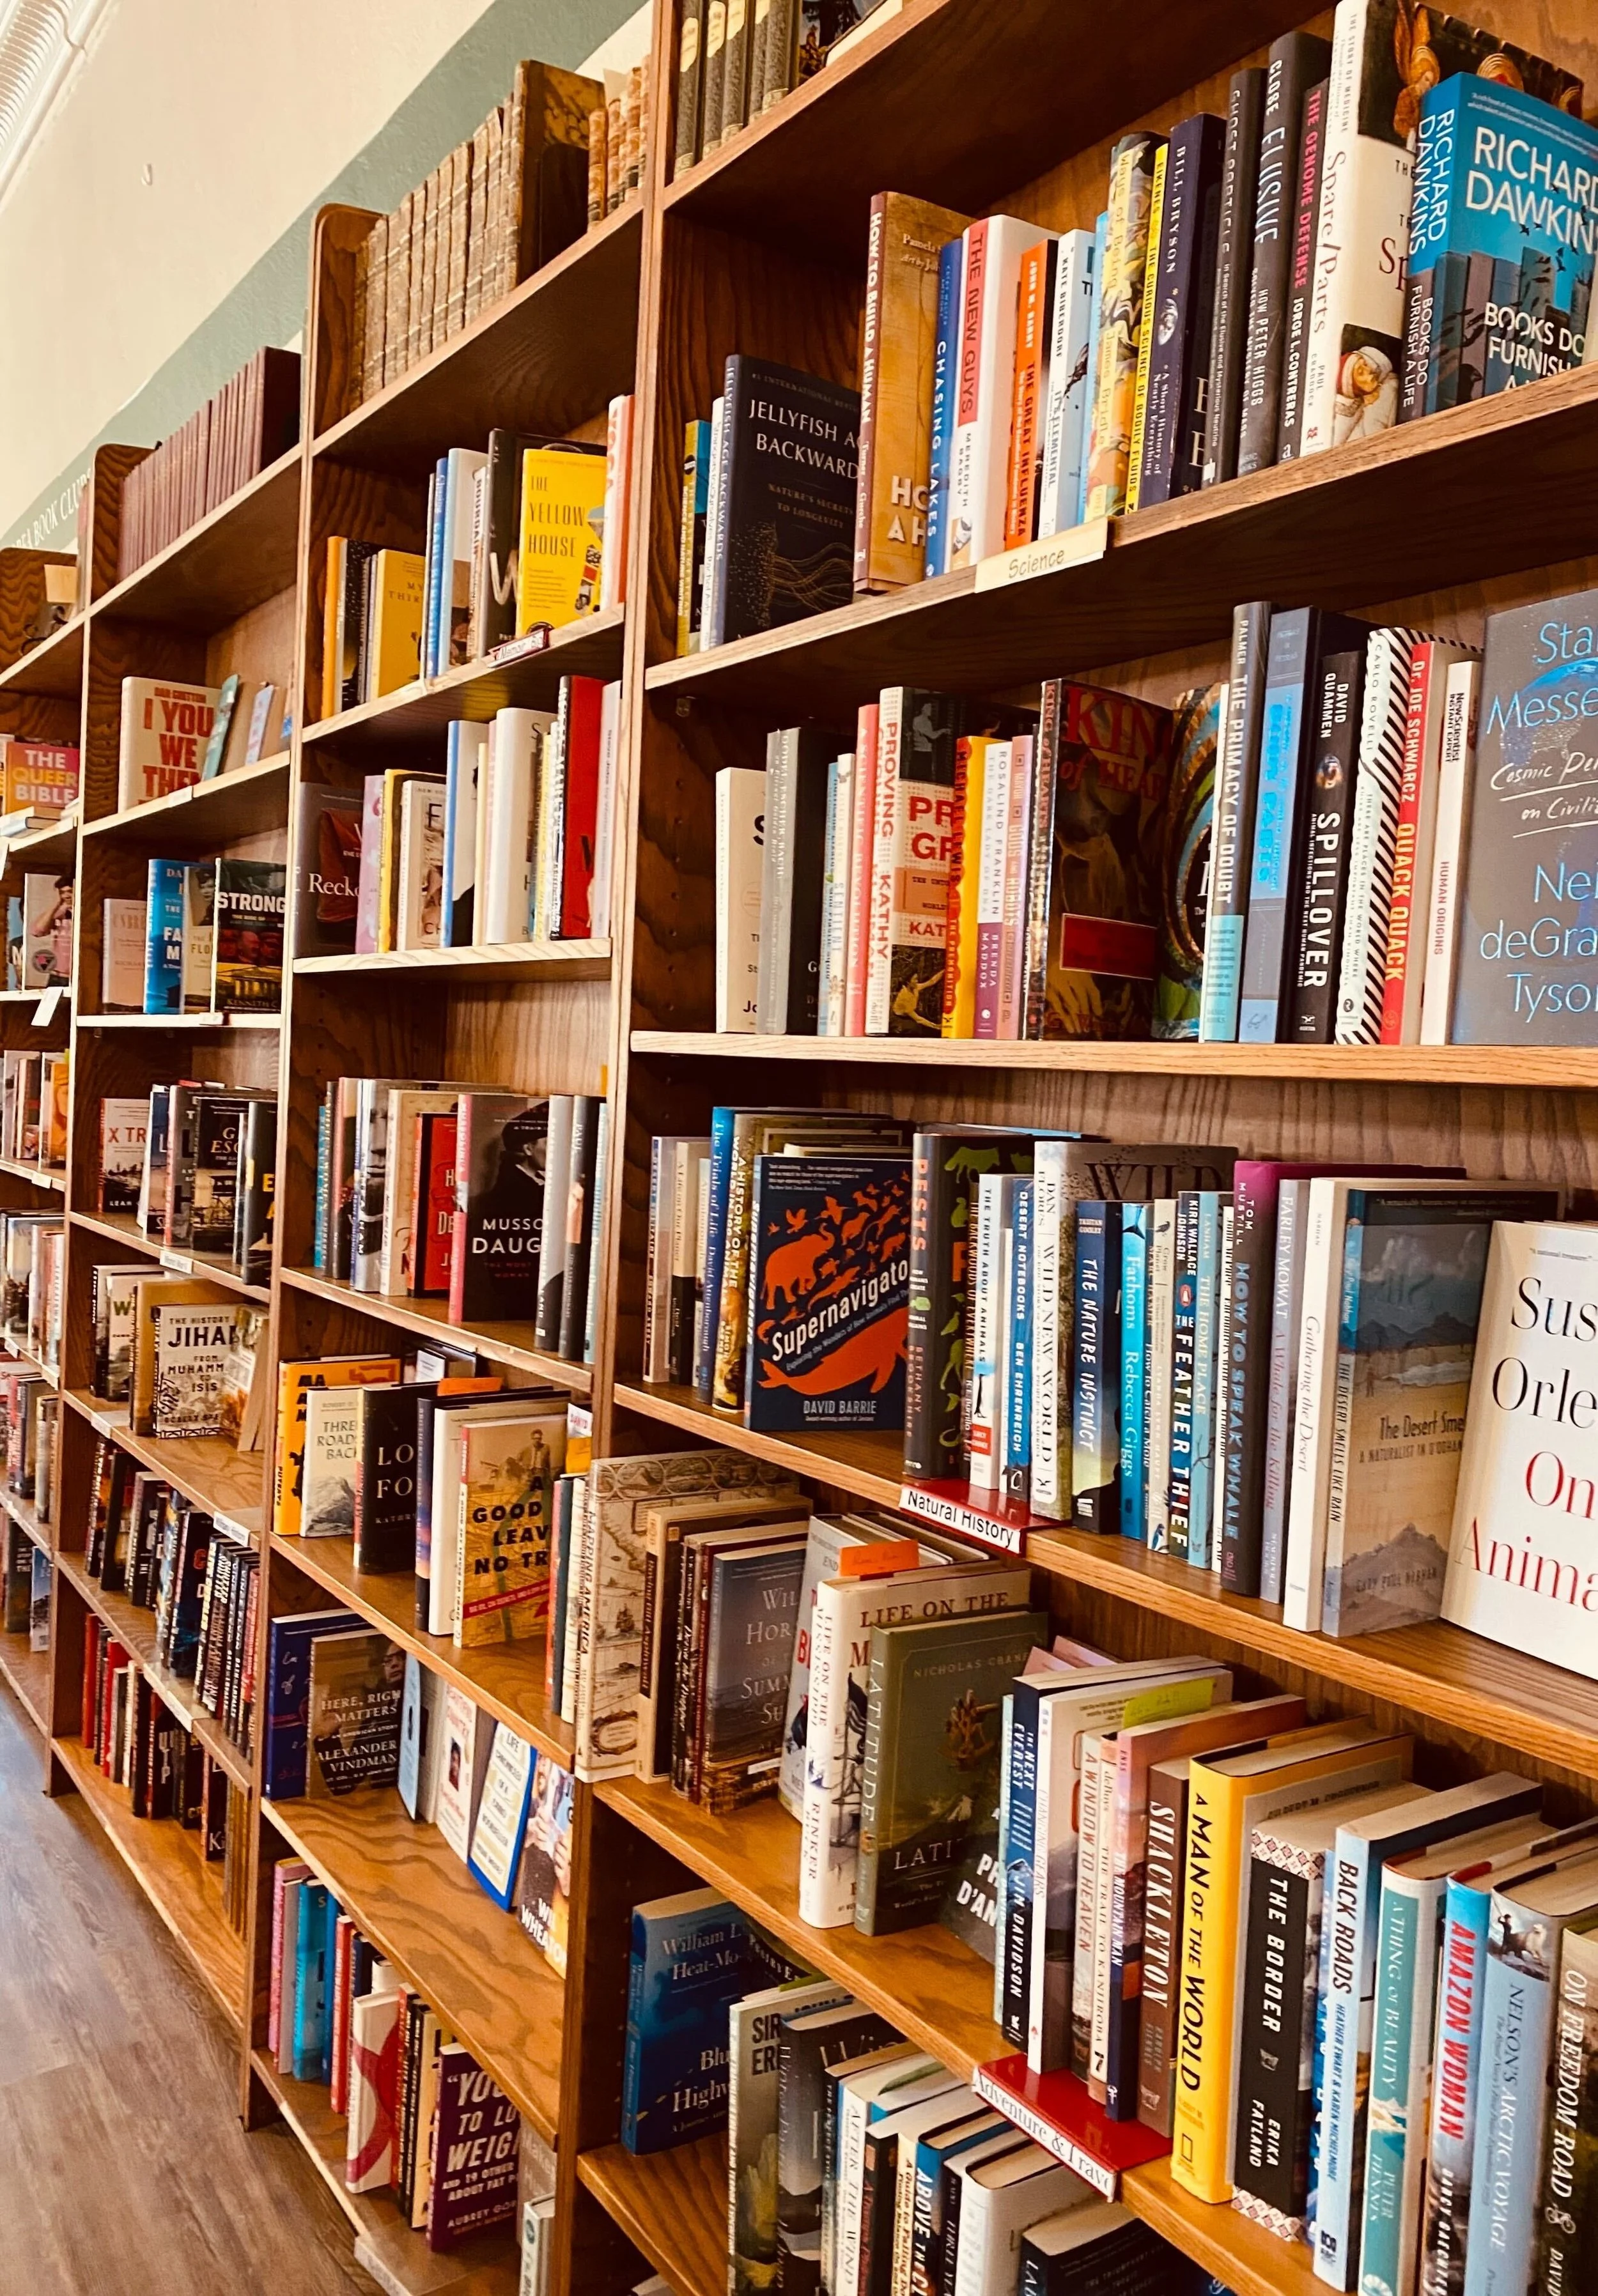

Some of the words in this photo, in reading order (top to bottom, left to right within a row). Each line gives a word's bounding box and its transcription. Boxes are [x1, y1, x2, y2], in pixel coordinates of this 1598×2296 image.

[1307, 90, 1321, 126] THE
[1301, 134, 1317, 206] GENOME
[1409, 115, 1436, 255] DAWKINS
[1426, 109, 1455, 242] RICHARD
[869, 212, 882, 258] HOW
[970, 233, 983, 280] THE
[1294, 215, 1311, 288] DEFENSE
[867, 261, 879, 287] TO
[865, 290, 878, 342] BUILD
[966, 288, 979, 341] NEW
[1408, 285, 1422, 355] FURNISH
[1420, 297, 1434, 355] BOOKS
[1484, 302, 1555, 346] BOOKS
[961, 350, 976, 413] GUYS
[1026, 362, 1035, 392] THE
[1406, 360, 1416, 371] A
[1416, 359, 1429, 385] DO
[861, 358, 875, 423] HUMAN
[933, 340, 947, 450] CHASING
[1403, 376, 1416, 407] LIFE
[749, 398, 837, 442] JELLYFISH
[1023, 397, 1034, 444] GREAT
[531, 475, 548, 491] THE
[962, 433, 972, 507] MEREDITH
[1018, 451, 1031, 536] INFLUENZA
[528, 502, 586, 528] YELLOW
[928, 463, 942, 537] LAKES
[527, 534, 577, 559] HOUSE
[1008, 548, 1065, 578] Science
[1236, 620, 1249, 664] PALMER
[1372, 643, 1383, 688] CARLO
[1229, 674, 1248, 712] THE
[1411, 661, 1425, 681] Dr.
[161, 700, 214, 737] YOU
[1320, 672, 1337, 738] QUAMMEN
[1335, 683, 1349, 723] DAVID
[1366, 695, 1379, 751] ROVELLI
[1409, 688, 1423, 713] JOE
[25, 750, 66, 768] THE
[159, 734, 198, 769] WE
[1223, 718, 1245, 805] PRIMACY
[1401, 718, 1421, 802] SCHWARCZ
[13, 768, 77, 787] QUEER
[882, 722, 897, 837] PROVING
[996, 751, 1007, 829] ROSALIND
[1491, 762, 1553, 791] Cosmic
[1222, 815, 1237, 837] OF
[992, 840, 1002, 915] FRANKLIN
[1216, 844, 1236, 903] DOUBT
[1392, 823, 1415, 898] QUACK
[1436, 861, 1450, 904] HUMAN
[877, 875, 891, 959] KATHY
[1304, 812, 1341, 987] SPILLOVER
[1385, 905, 1409, 980] QUACK
[1434, 908, 1447, 955] ORIGINS
[980, 932, 989, 989] MADDOX
[989, 934, 999, 987] BRENDA
[983, 1189, 992, 1212] THE
[1018, 1192, 1028, 1238] DESERT
[1046, 1182, 1055, 1213] DAN
[1186, 1200, 1198, 1225] KIRK
[1237, 1182, 1246, 1245] MUSTILL
[1246, 1200, 1255, 1230] TOM
[982, 1217, 991, 1256] TRUTH
[1176, 1212, 1187, 1260] JOHNSON
[1278, 1196, 1293, 1253] FARLEY
[1042, 1245, 1055, 1304] WILD
[1083, 1259, 1098, 1291] THE
[1184, 1228, 1197, 1275] WALLACE
[981, 1262, 989, 1303] ABOUT
[1016, 1245, 1027, 1320] NOTEBOOKS
[1125, 1256, 1140, 1329] Fathoms
[1233, 1262, 1249, 1321] HOW
[1275, 1258, 1292, 1318] MOWAT
[977, 1308, 988, 1362] ANIMALS
[1015, 1342, 1025, 1366] BEN
[1042, 1310, 1053, 1362] NEW
[1080, 1298, 1096, 1364] NATURE
[1232, 1330, 1248, 1360] TO
[192, 1383, 217, 1392] ISIS
[1124, 1351, 1140, 1420] Rebecca
[1174, 1334, 1193, 1452] FEATHER
[1338, 1362, 1351, 1382] THE
[803, 1400, 837, 1414] DAVID
[839, 1400, 876, 1414] BARRIE
[1013, 1372, 1024, 1452] EHRENREICH
[1040, 1369, 1053, 1463] WORLD
[1079, 1373, 1095, 1452] INSTINCT
[1228, 1368, 1245, 1448] SPEAK
[1336, 1385, 1349, 1422] DESERT
[1121, 1427, 1138, 1477] Giggs
[1333, 1428, 1347, 1464] SMELLS
[529, 1475, 543, 1491] A
[1224, 1454, 1241, 1539] WHALE
[1332, 1468, 1344, 1493] LIKE
[472, 1500, 542, 1523] GOOD
[908, 1491, 958, 1522] Natural
[961, 1508, 1013, 1548] History
[1170, 1467, 1190, 1547] THIEF
[1330, 1497, 1342, 1523] RAIN
[474, 1555, 509, 1576] NO
[860, 1603, 913, 1628] LIFE
[922, 1599, 955, 1620] ON
[965, 1590, 1009, 1607] THE
[821, 1616, 834, 1658] LIFE
[820, 1662, 832, 1683] ON
[913, 1658, 982, 1678] NICHOLAS
[818, 1690, 830, 1727] THE
[318, 1741, 397, 1761] ALEXANDER
[330, 1753, 397, 1771] VINDMAN
[862, 1659, 884, 1821] LATITUDE
[1012, 1723, 1025, 1789] EVEREST
[1086, 1752, 1098, 1762] A
[1024, 1752, 1034, 1790] NEXT
[1083, 1771, 1097, 1842] WINDOW
[1196, 1792, 1207, 1806] A
[1082, 1852, 1094, 1871] TO
[1189, 1814, 1213, 1890] MAN
[1014, 1876, 1027, 1906] JIM
[1143, 1801, 1175, 2007] SHACKLETON
[1190, 1892, 1203, 1920] OF
[1267, 1879, 1289, 1924] THE
[1335, 1860, 1358, 1918] BACK
[1078, 1877, 1093, 1953] HEAVEN
[663, 1930, 724, 1955] William
[1011, 1913, 1024, 1997] DAVIDSON
[1188, 1929, 1203, 1969] THE
[1333, 1924, 1354, 1994] ROADS
[1262, 1935, 1285, 2032] BORDER
[1447, 1922, 1475, 2033] AMAZON
[1565, 1970, 1586, 2005] ON
[1180, 1975, 1206, 2092] WORLD
[1335, 2004, 1346, 2043] HEATHER
[1503, 1983, 1524, 2084] NELSON'S
[1332, 2046, 1344, 2077] EWART
[1554, 2012, 1583, 2126] FREEDOM
[1330, 2090, 1342, 2120] KAREN
[1439, 2038, 1470, 2140] WOMAN
[458, 2111, 483, 2135] TO
[975, 2075, 1047, 2139] Adventure
[1052, 2132, 1065, 2156] &
[1249, 2099, 1265, 2167] FATLAND
[1496, 2087, 1517, 2166] ARCTIC
[1266, 2119, 1280, 2166] ERIKA
[1327, 2122, 1341, 2182] MICHELMORE
[1549, 2132, 1576, 2198] ROAD
[914, 2168, 933, 2238] ABOVE
[1490, 2171, 1510, 2253] VOYAGE
[913, 2243, 926, 2271] THE
